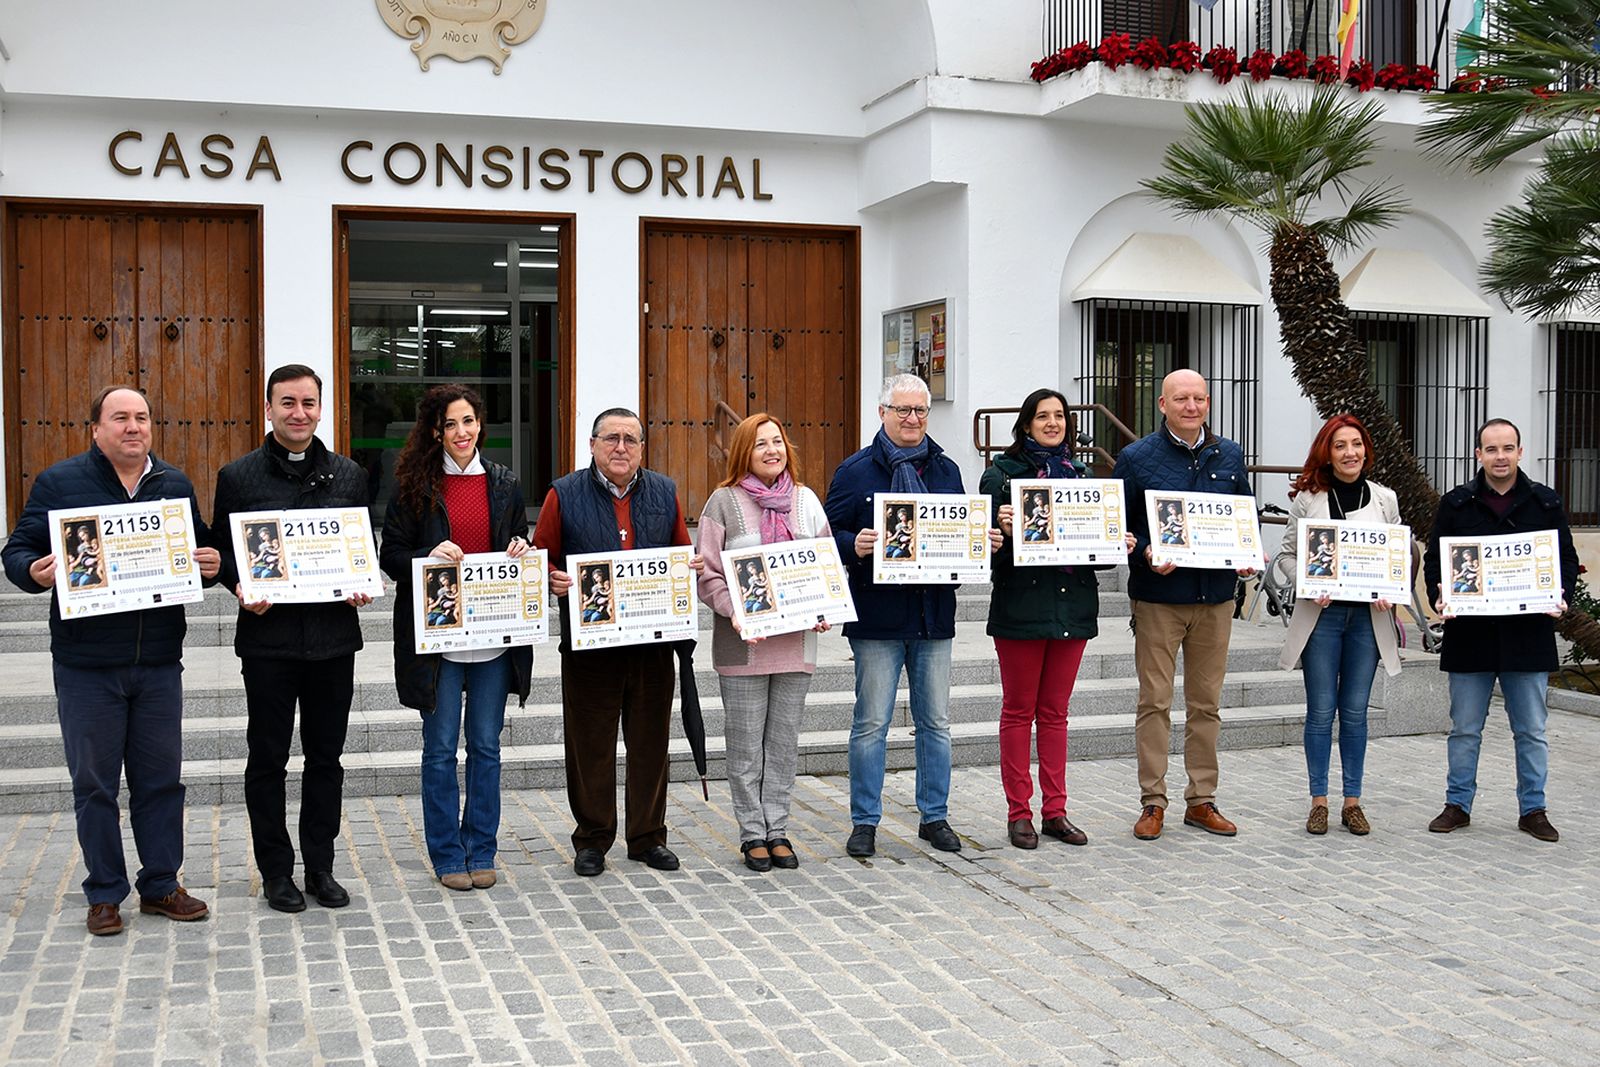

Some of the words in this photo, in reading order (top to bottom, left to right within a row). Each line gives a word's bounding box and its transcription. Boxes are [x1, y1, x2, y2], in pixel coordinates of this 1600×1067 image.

[442, 31, 460, 43] AÑO
[462, 34, 470, 43] C
[471, 33, 478, 43] V
[108, 130, 282, 182] CASA
[341, 140, 773, 201] CONSISTORIAL
[1055, 490, 1101, 503] 21159
[919, 505, 967, 520] 21159
[1188, 502, 1233, 516] 21159
[103, 514, 161, 535] 21159
[284, 520, 340, 536] 21159
[1341, 530, 1386, 545] 21159
[1484, 543, 1532, 559] 21159
[174, 557, 186, 566] 20
[768, 550, 816, 569] 21159
[464, 564, 519, 582] 21159
[615, 560, 668, 577] 21159
